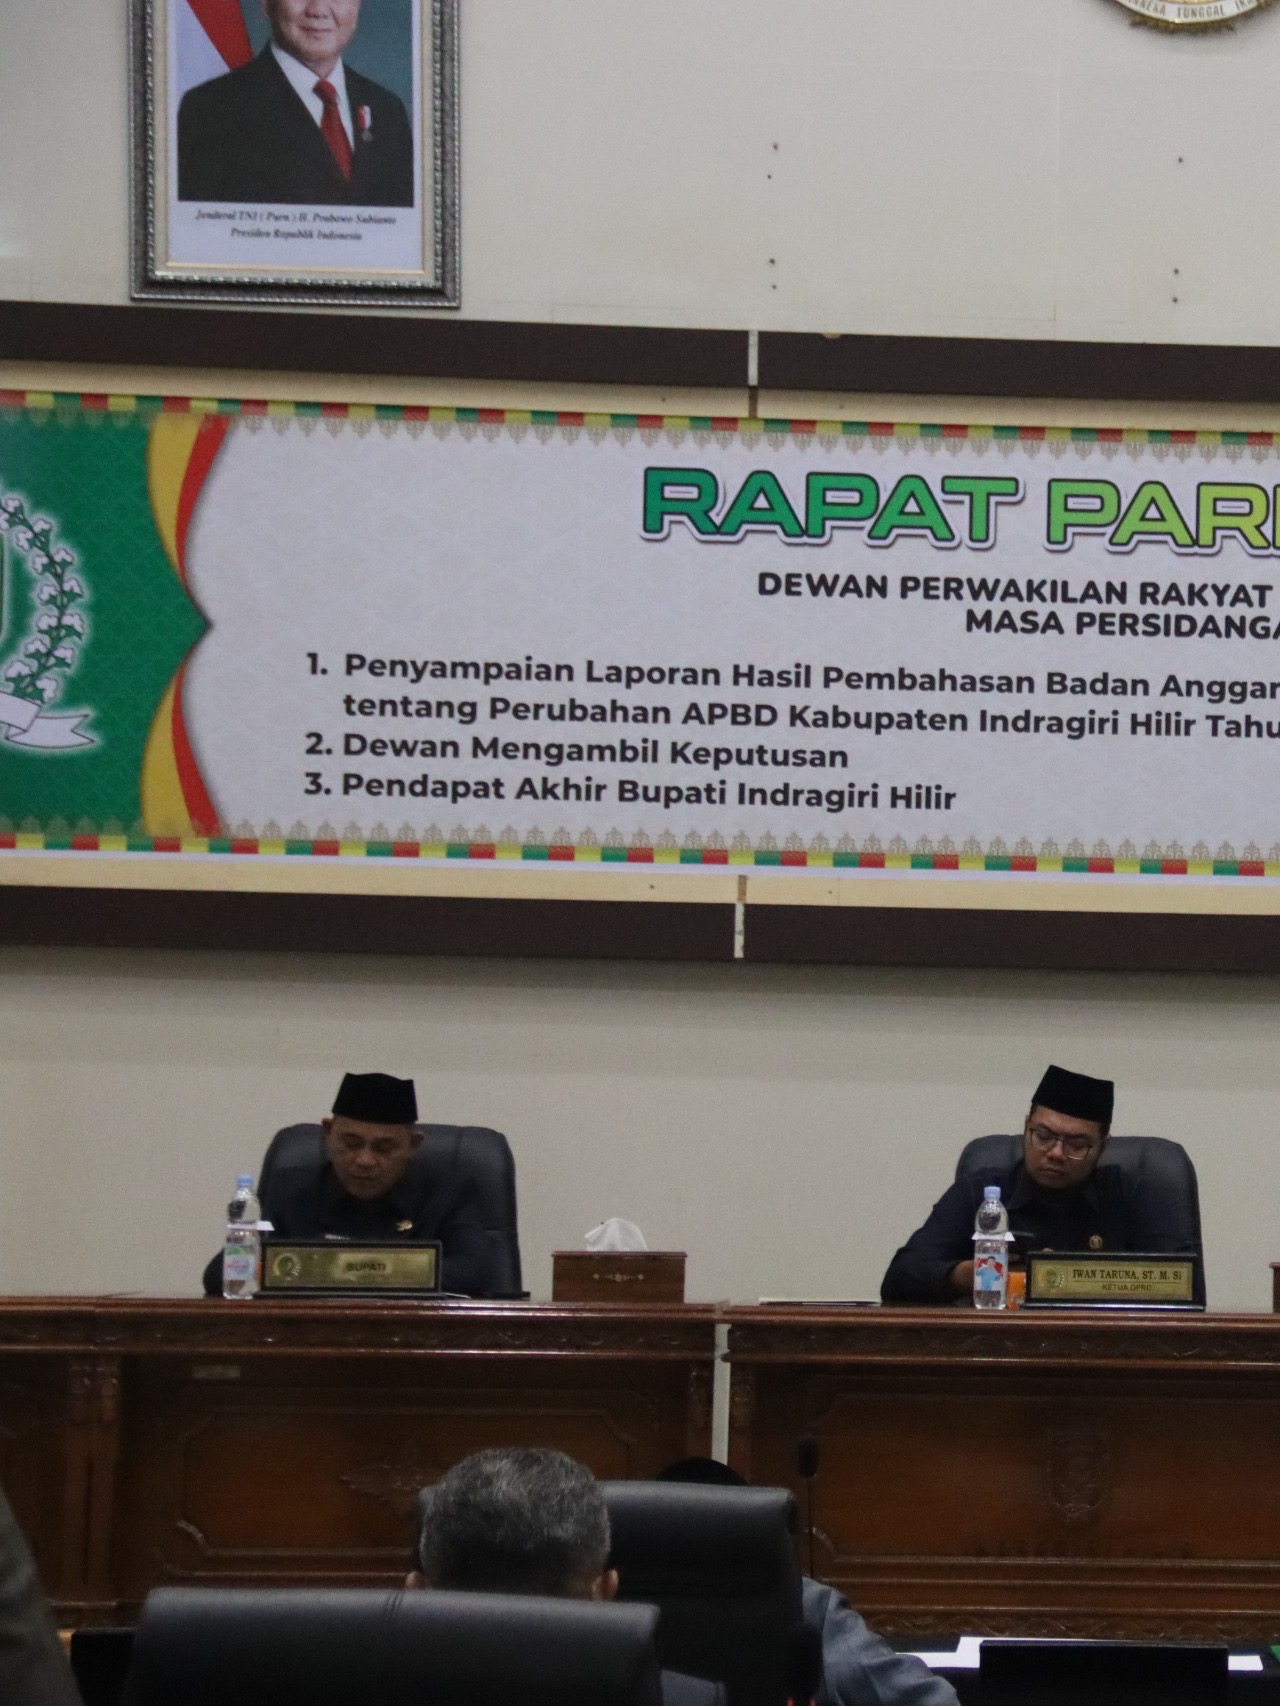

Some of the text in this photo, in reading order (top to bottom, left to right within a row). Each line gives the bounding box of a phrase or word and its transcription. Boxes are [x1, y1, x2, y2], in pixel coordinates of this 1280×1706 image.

[1176, 5, 1225, 19] TUNGGAL
[643, 467, 1020, 543] RAPAT
[757, 571, 888, 600] DEWAN
[899, 575, 1128, 606] PERWAKILAN
[1139, 581, 1274, 609] RAKYAT
[965, 608, 1065, 636] MASA
[306, 652, 329, 676] 1.
[345, 653, 575, 686] Penyampaian
[586, 659, 721, 690] Laporan
[732, 662, 812, 689] Hasil
[823, 666, 1035, 694] Pembahasan
[1046, 671, 1150, 697] Badan
[342, 694, 478, 726] tentang
[489, 696, 671, 725] Perubahan
[681, 701, 779, 727] APBD
[789, 704, 968, 736] Kabupaten
[979, 708, 1120, 741] Indragiri
[1130, 710, 1197, 737] Hilir
[305, 731, 849, 772] 2. Dewan Mengambil Keputusan
[303, 771, 957, 814] 3. Pendapat Akhir Bupati Indragiri Hilir
[346, 1262, 387, 1272] BUPATI
[1073, 1269, 1096, 1279] IWAN
[1102, 1284, 1129, 1292] KETUA
